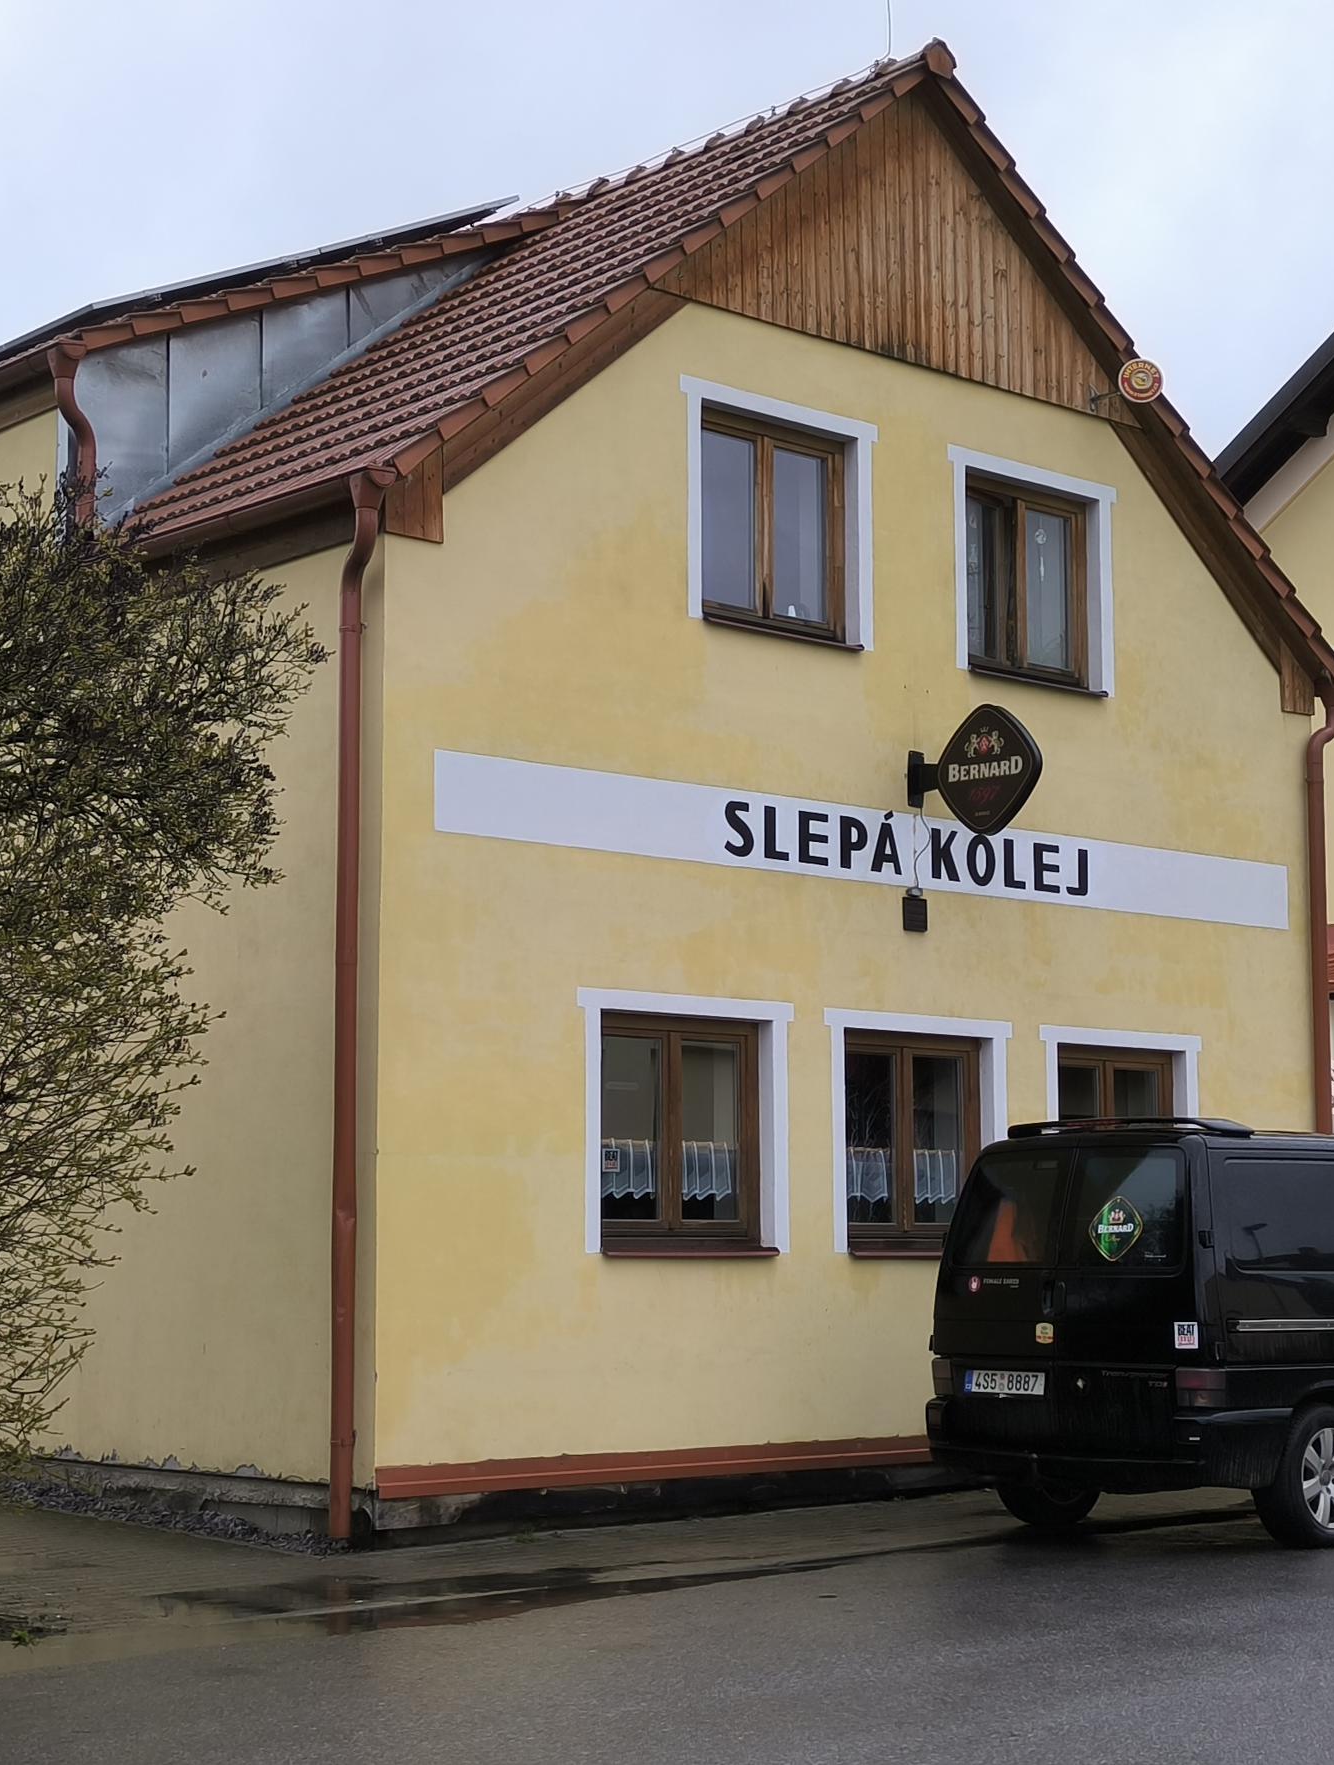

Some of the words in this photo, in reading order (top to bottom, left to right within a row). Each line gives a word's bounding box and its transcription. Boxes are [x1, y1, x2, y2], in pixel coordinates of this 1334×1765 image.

[948, 755, 1023, 783] BERNARD
[724, 801, 902, 875] SLEPÁ
[931, 828, 1088, 896] KOLEJ
[1097, 1223, 1134, 1234] BERNARD
[975, 1372, 998, 1390] 4S5
[1007, 1373, 1039, 1392] 8887
